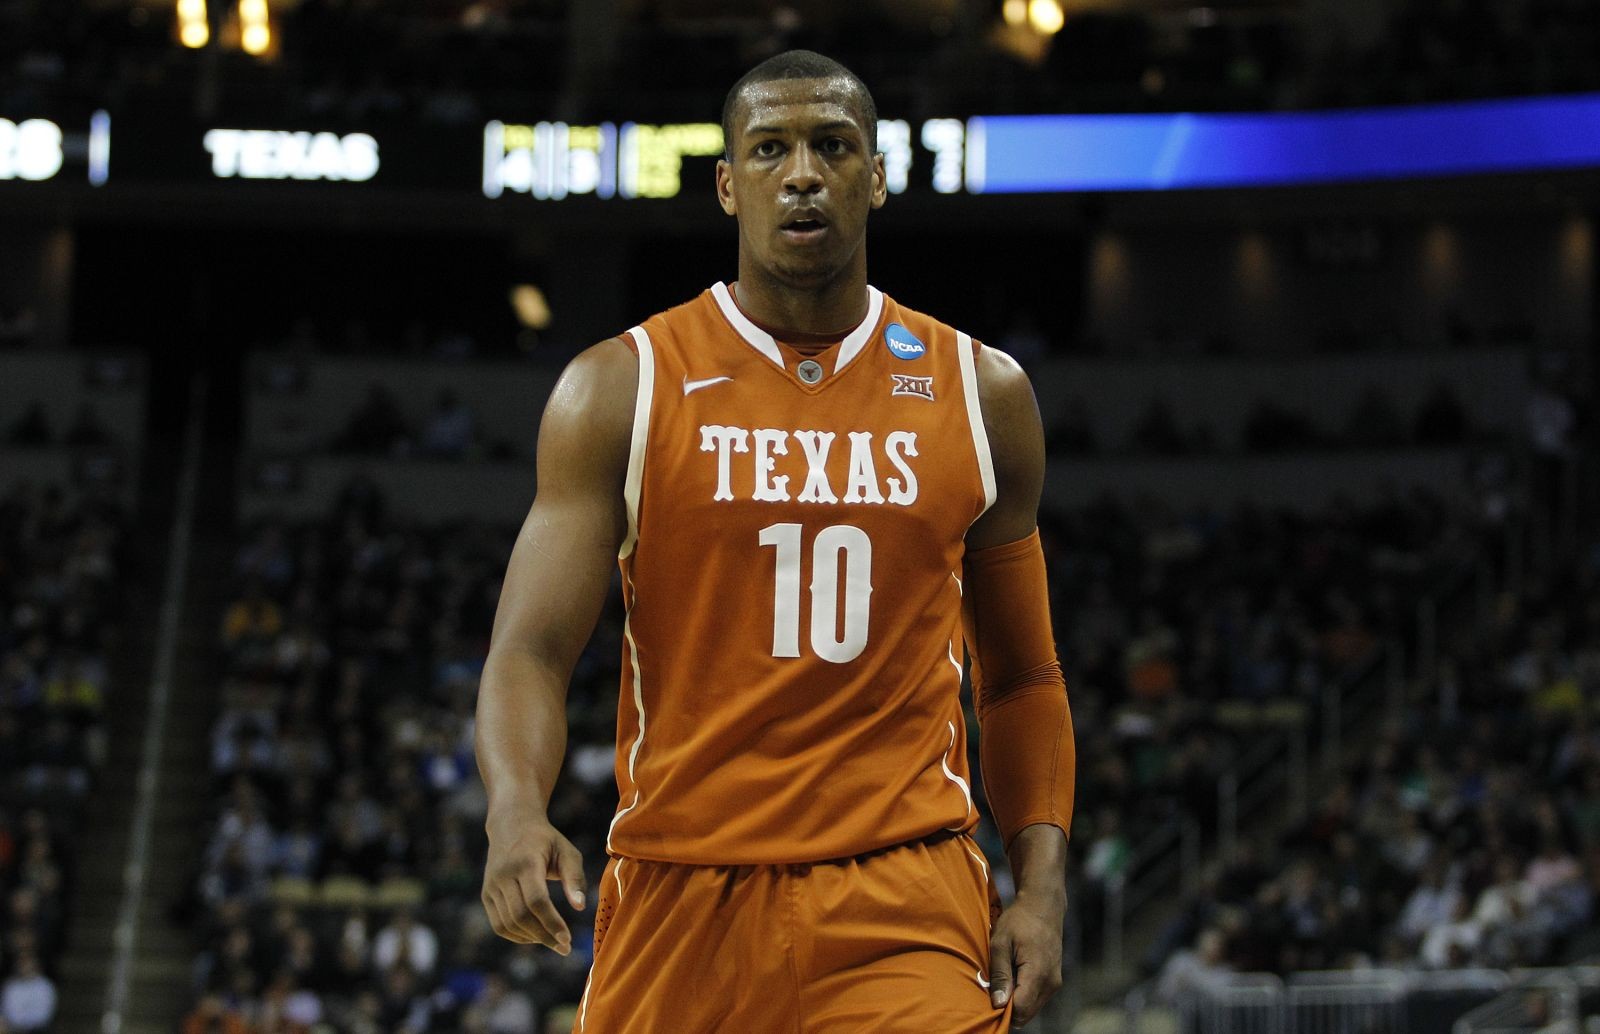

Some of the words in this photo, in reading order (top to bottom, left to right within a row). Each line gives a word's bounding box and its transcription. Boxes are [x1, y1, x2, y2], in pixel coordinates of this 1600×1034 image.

[205, 129, 379, 181] TEXAS
[889, 338, 924, 353] NCAA
[893, 375, 932, 399] XII
[699, 424, 920, 506] TEXAS
[757, 523, 874, 664] 10
